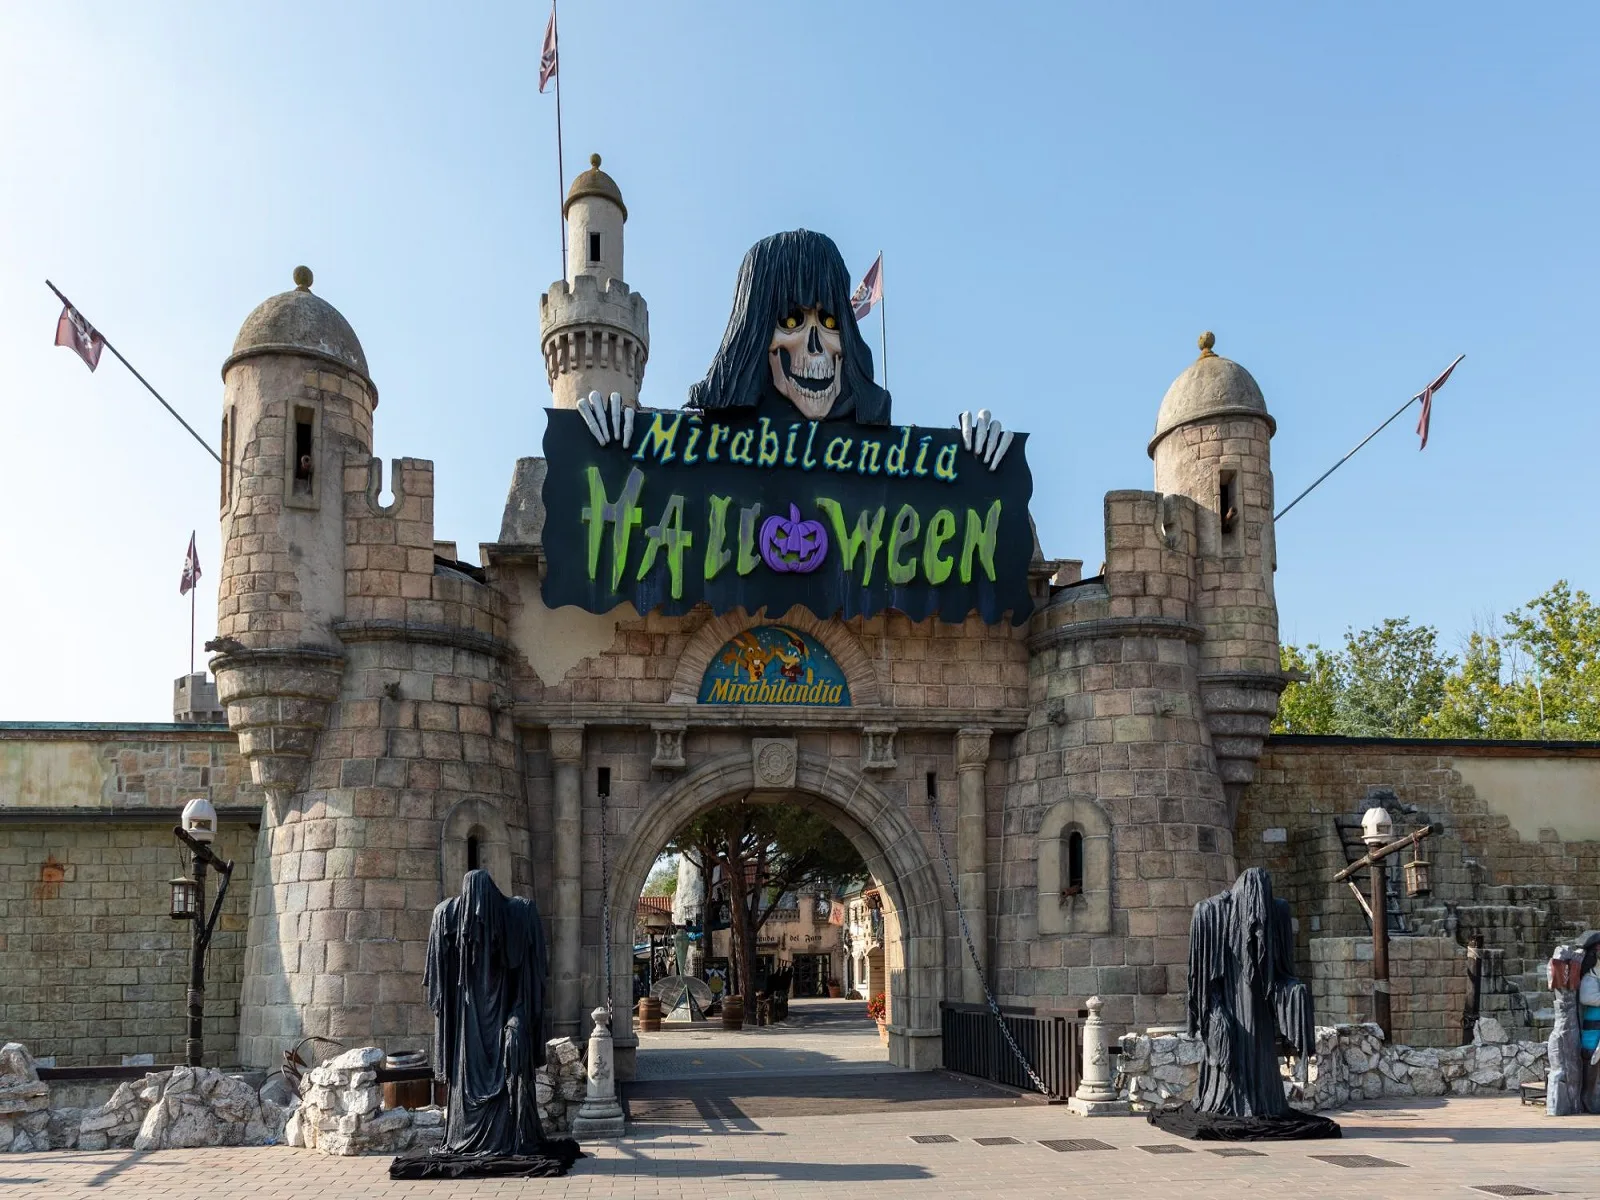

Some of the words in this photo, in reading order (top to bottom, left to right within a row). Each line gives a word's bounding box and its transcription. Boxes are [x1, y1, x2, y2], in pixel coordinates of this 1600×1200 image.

[632, 412, 959, 482] Mirabilandia
[705, 677, 844, 704] Mirabilandia
[804, 934, 822, 943] Faro
